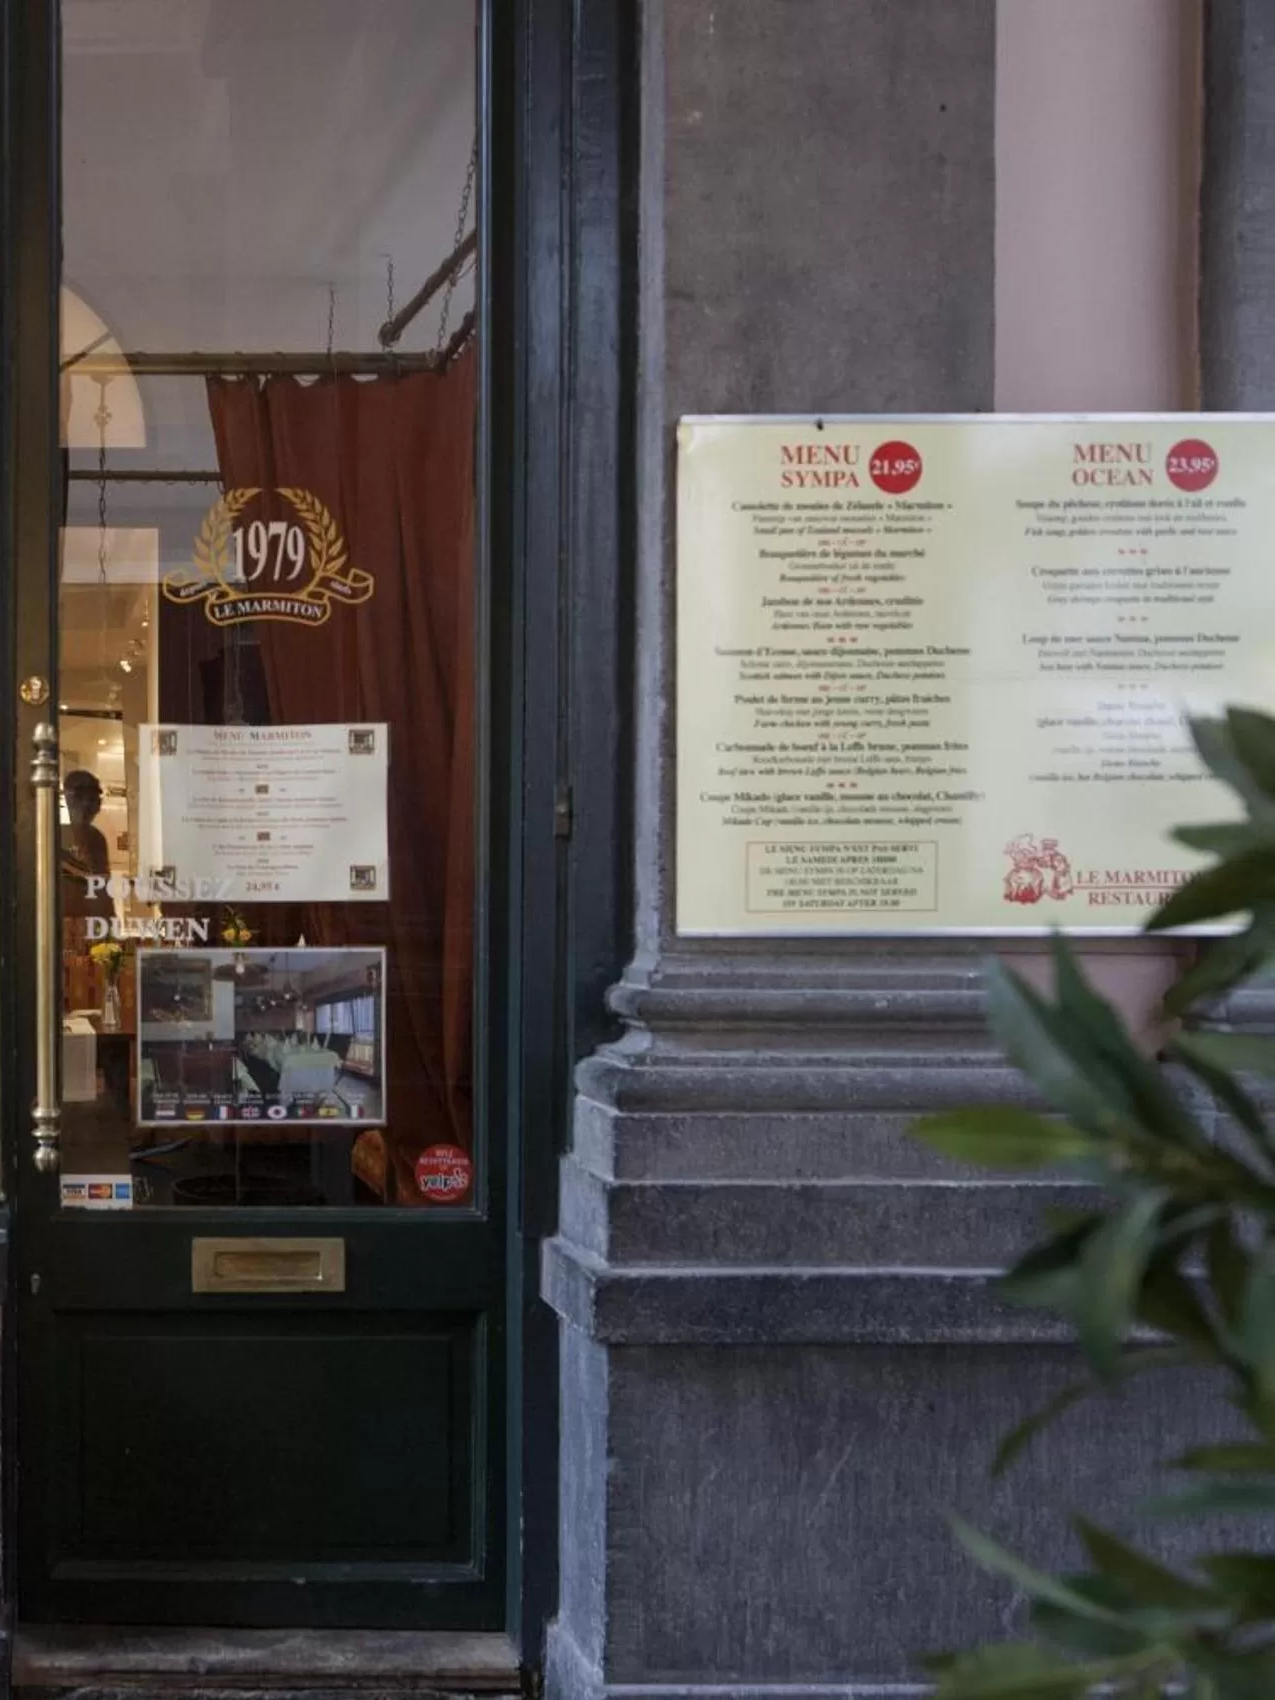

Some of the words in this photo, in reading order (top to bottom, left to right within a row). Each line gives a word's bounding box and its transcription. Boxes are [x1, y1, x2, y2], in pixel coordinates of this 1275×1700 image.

[781, 445, 860, 465] MENU
[1073, 443, 1152, 464] MENU
[781, 470, 860, 488] SYMPA
[1072, 468, 1154, 487] OCEAN
[232, 520, 305, 581] 1979
[214, 602, 236, 619] LE
[237, 600, 323, 618] MARMITON
[86, 875, 235, 899] POUSSEZ
[1076, 870, 1099, 885] LE
[85, 917, 210, 942] DUWEN
